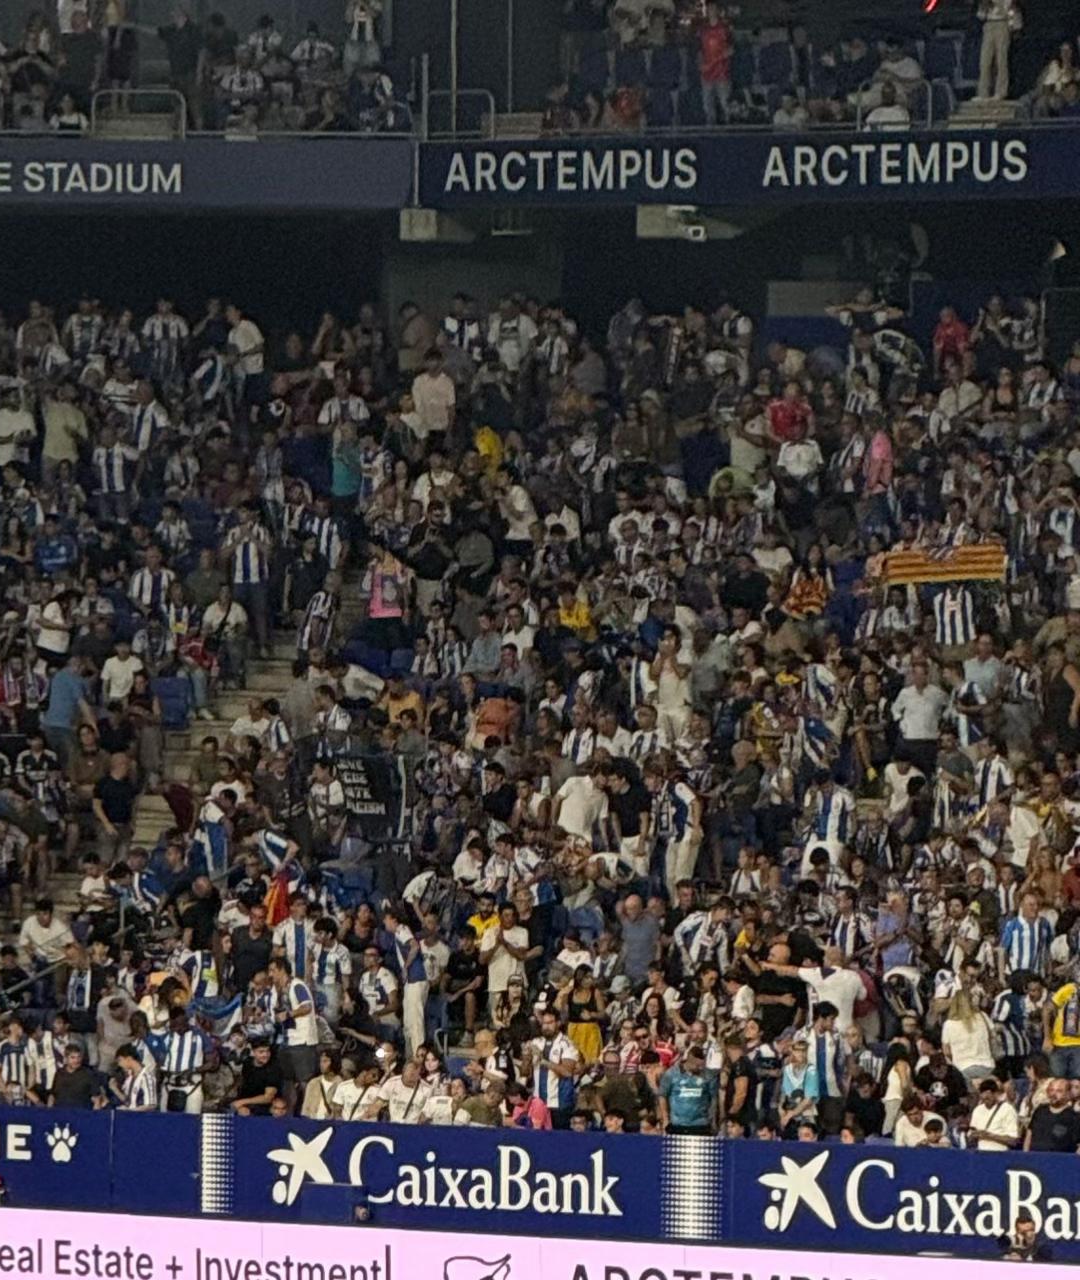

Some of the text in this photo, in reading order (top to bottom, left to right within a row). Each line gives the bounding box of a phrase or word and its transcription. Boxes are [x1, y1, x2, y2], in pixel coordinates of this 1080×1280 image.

[23, 161, 182, 193] STADIUM
[445, 148, 697, 191] ARCTEMPUS
[763, 141, 1027, 187] ARCTEMPUS
[349, 1135, 623, 1216] CaixaBank
[846, 1159, 1080, 1242] CaixaBa
[54, 1239, 153, 1280] Estate
